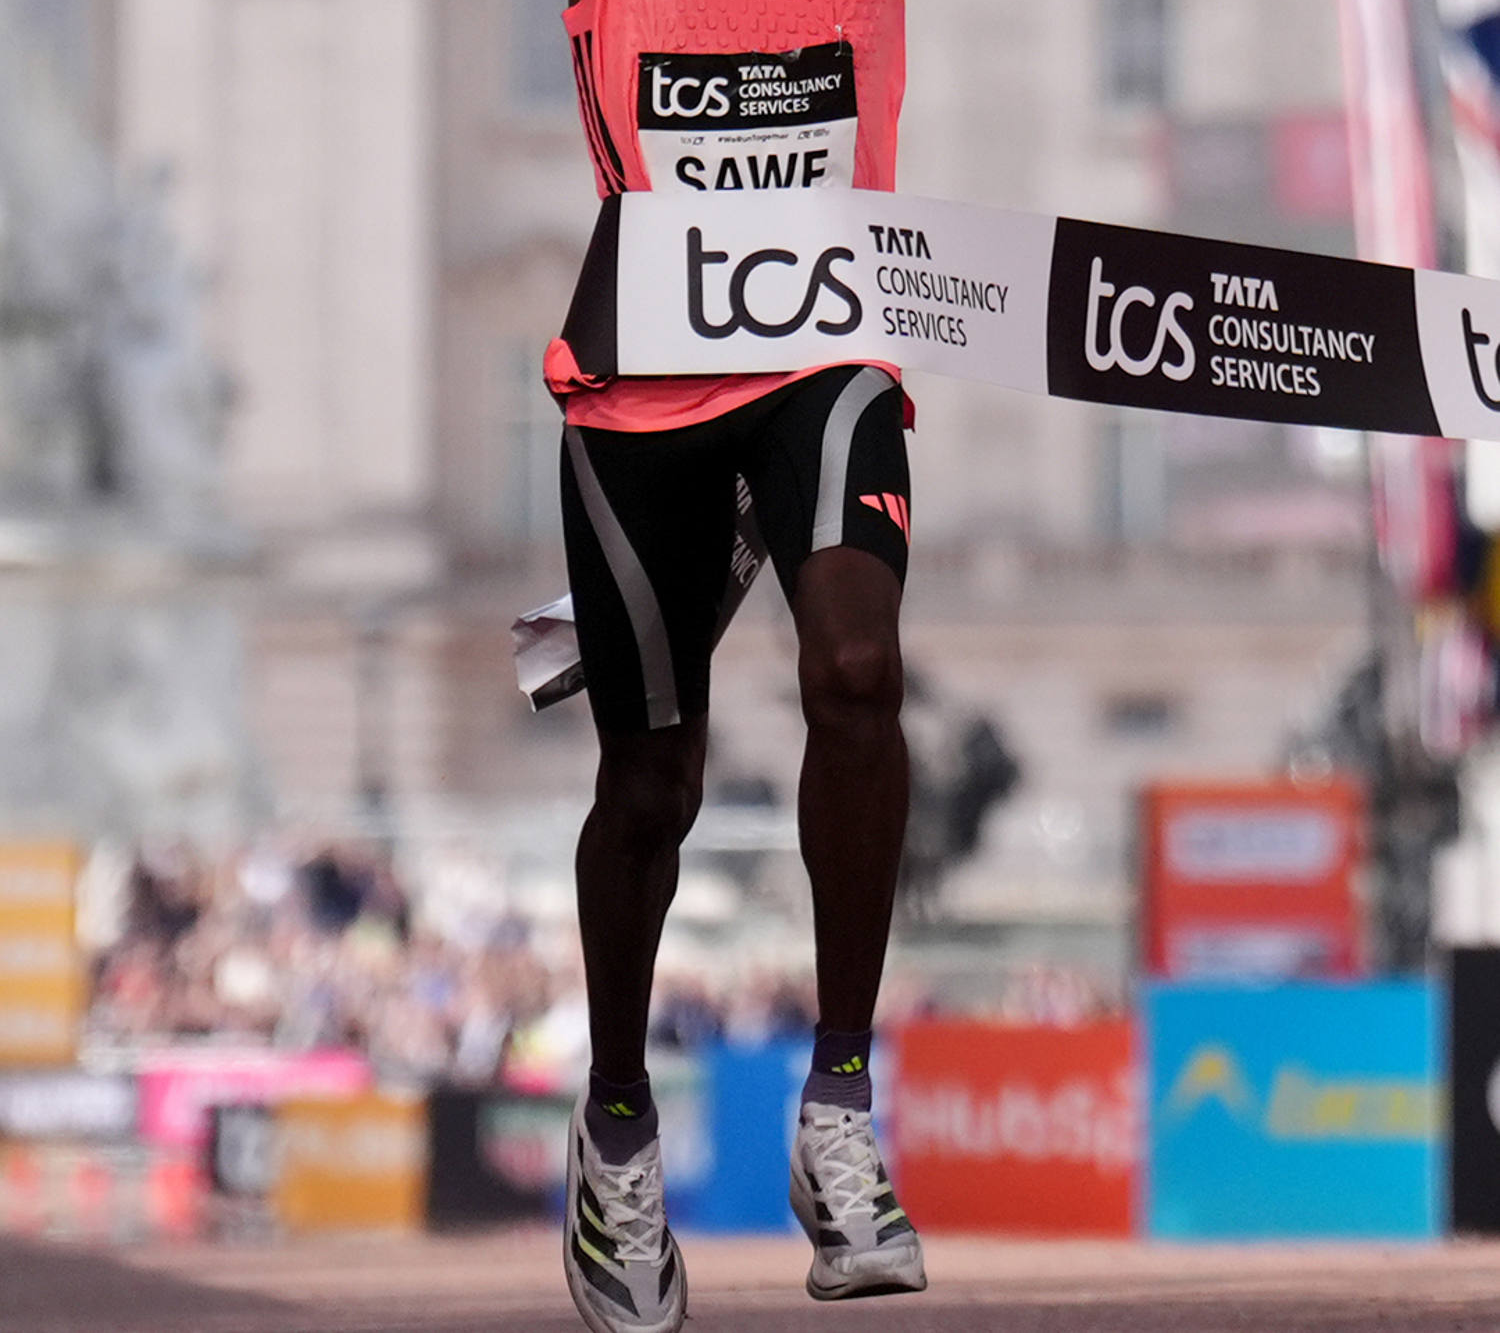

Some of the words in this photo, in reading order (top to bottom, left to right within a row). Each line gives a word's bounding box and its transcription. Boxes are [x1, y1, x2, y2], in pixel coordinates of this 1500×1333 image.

[652, 65, 730, 118] tcs
[738, 65, 787, 81] TATA
[738, 73, 842, 98] CONSULTANCY
[739, 97, 810, 117] SERVICES
[869, 225, 932, 260] TATA
[687, 226, 863, 340] tcs
[876, 266, 1009, 314] CONSULTANCY
[1211, 272, 1279, 311] TATA
[884, 306, 968, 348] SERVICES
[1085, 256, 1196, 382] tcs
[1208, 314, 1375, 364] CONSULTANCY
[1210, 355, 1321, 397] SERVICES
[1461, 307, 1500, 414] t
